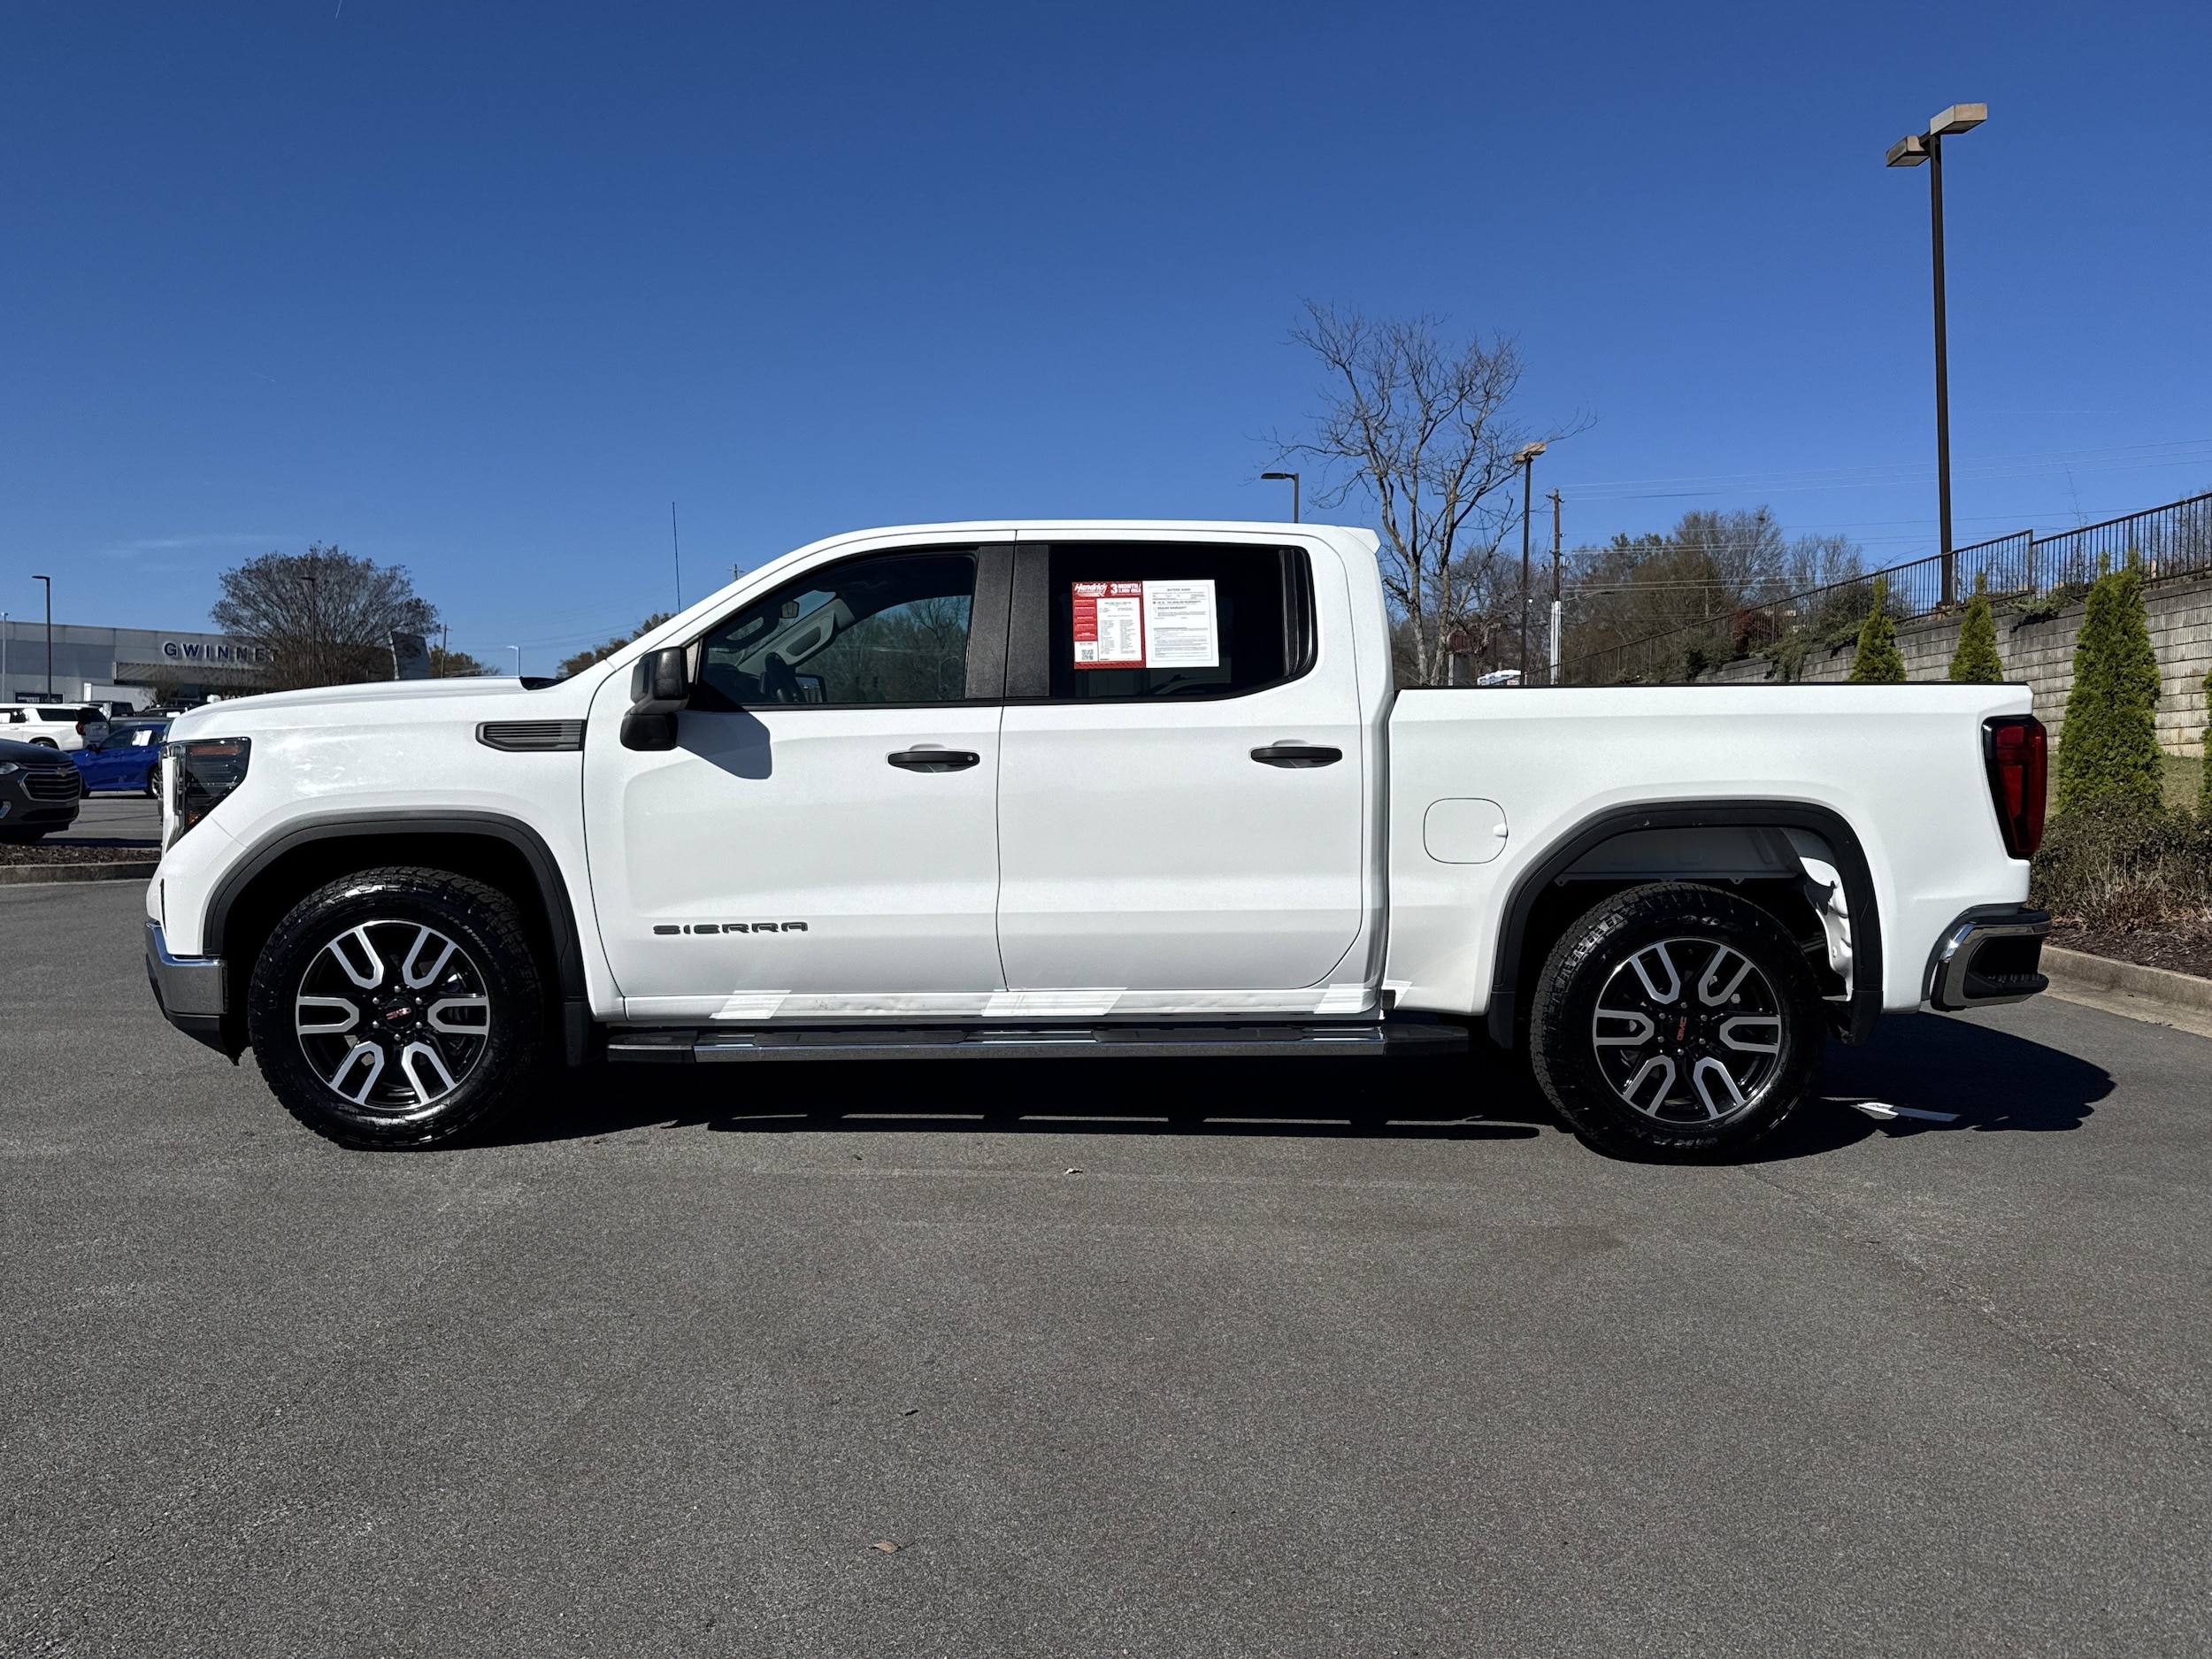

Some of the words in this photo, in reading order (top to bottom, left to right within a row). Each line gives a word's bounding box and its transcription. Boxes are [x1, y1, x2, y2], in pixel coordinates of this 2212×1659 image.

[1074, 583, 1108, 594] Hendrick
[1110, 584, 1118, 594] 3
[652, 921, 809, 935] SIERRA
[386, 1007, 412, 1020] GMC
[1677, 1016, 1687, 1041] GMC
